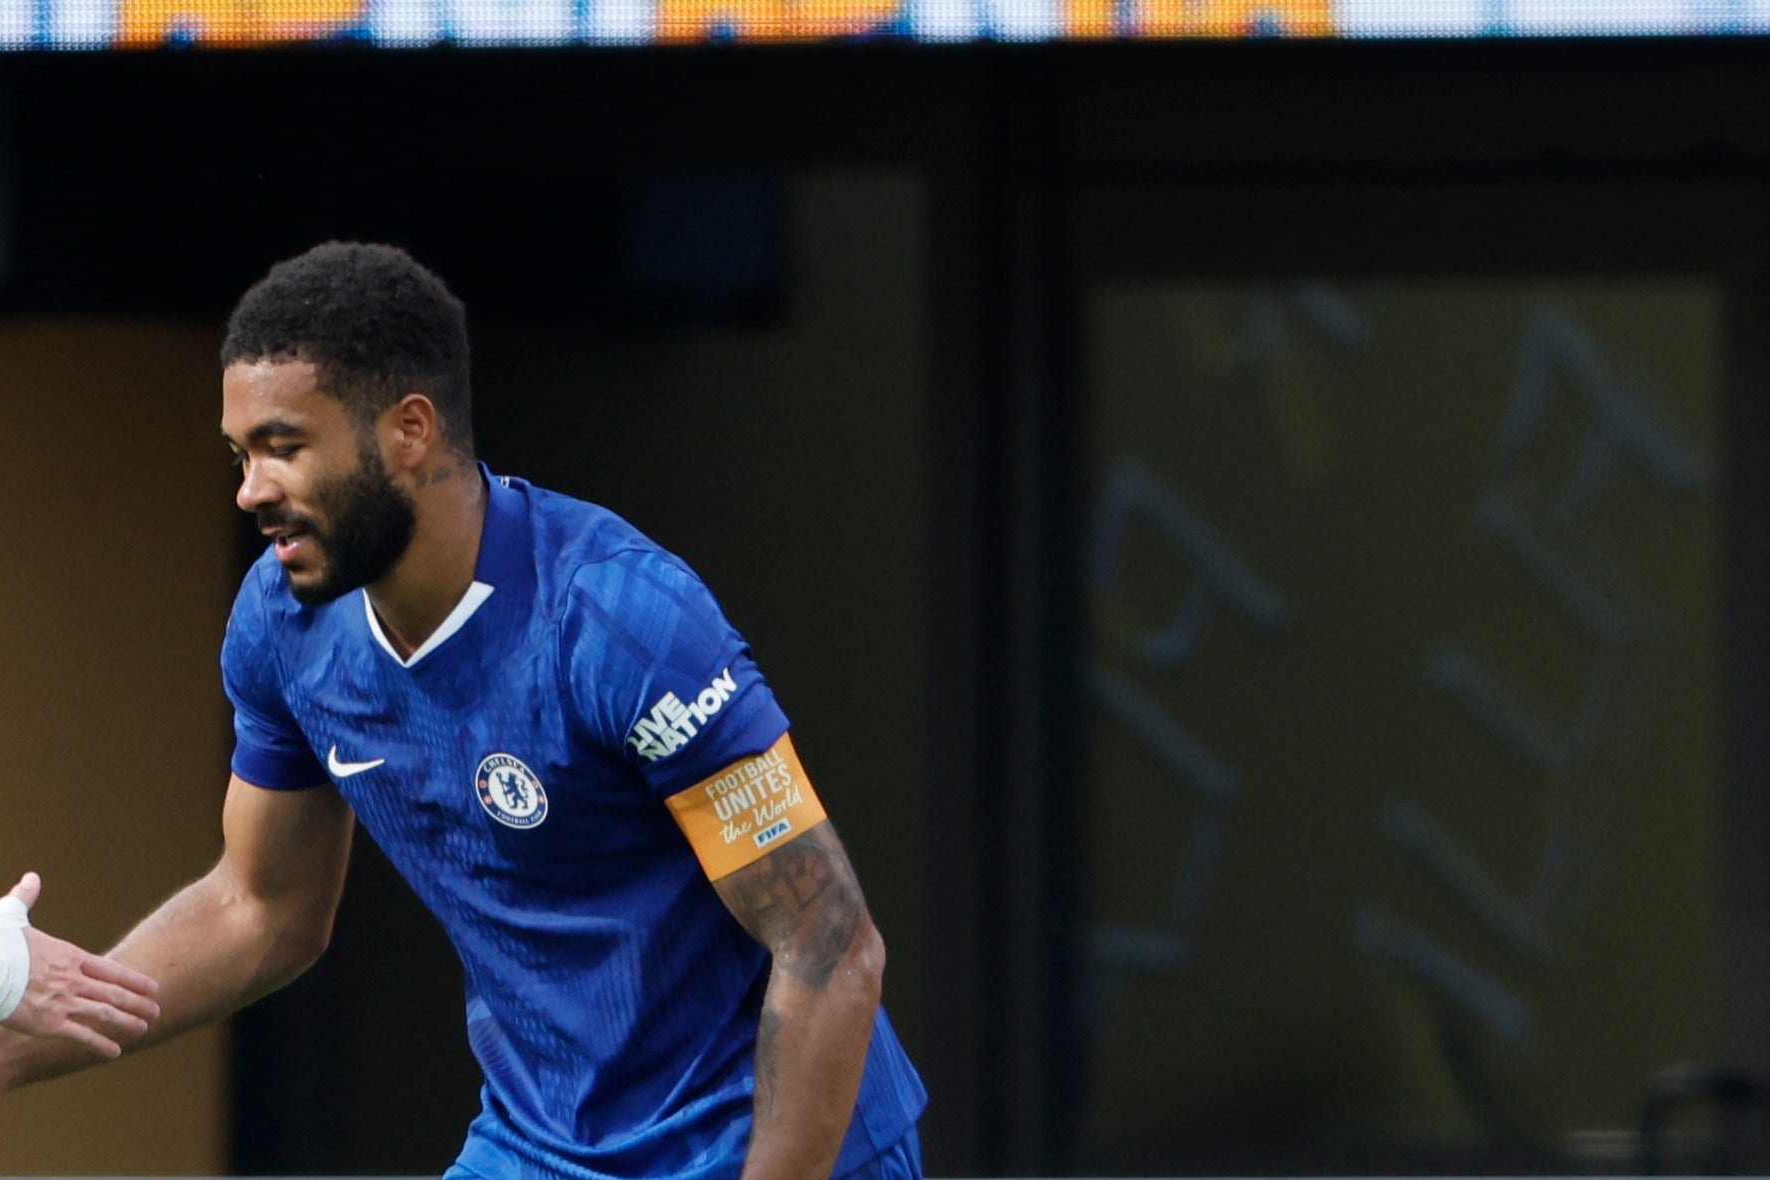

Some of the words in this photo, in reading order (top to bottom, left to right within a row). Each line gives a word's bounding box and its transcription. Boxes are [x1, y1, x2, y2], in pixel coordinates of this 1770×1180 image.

[627, 691, 688, 753] LIVE
[637, 667, 737, 762] NATION
[705, 748, 784, 800] FOOTBALL
[713, 763, 792, 822] UNITES
[719, 820, 752, 845] the
[752, 784, 803, 827] World
[756, 822, 789, 844] FIFA
